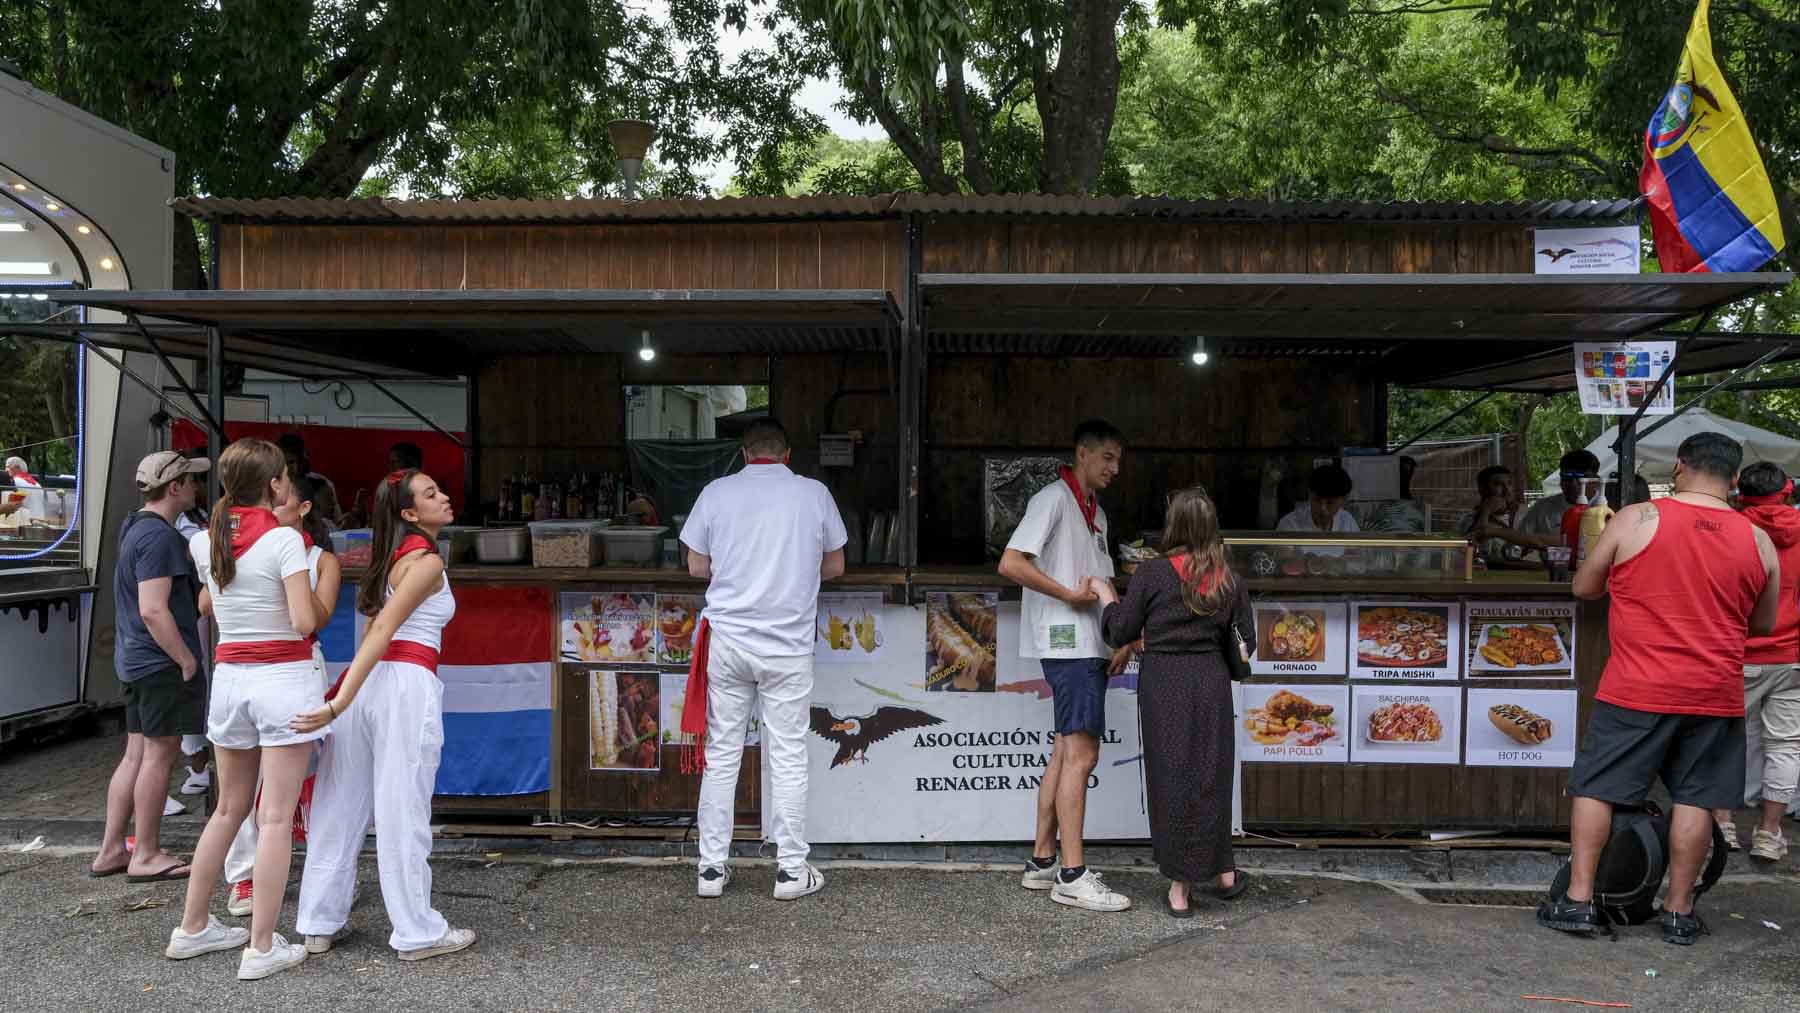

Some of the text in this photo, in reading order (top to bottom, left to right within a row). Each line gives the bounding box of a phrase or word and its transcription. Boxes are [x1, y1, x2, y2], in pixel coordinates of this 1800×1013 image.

[1535, 607, 1570, 616] MIXTO
[1273, 663, 1317, 671] HORNADO
[1372, 670, 1400, 678] TRIPA
[1378, 695, 1431, 703] SALCHIPAPA
[914, 728, 1041, 747] ASOCIACIÓN
[1263, 746, 1323, 756] PAPI POLLO
[1498, 751, 1542, 760] HOT DOG
[952, 753, 1053, 769] CULTURA
[916, 773, 1099, 791] RENACER ANO
